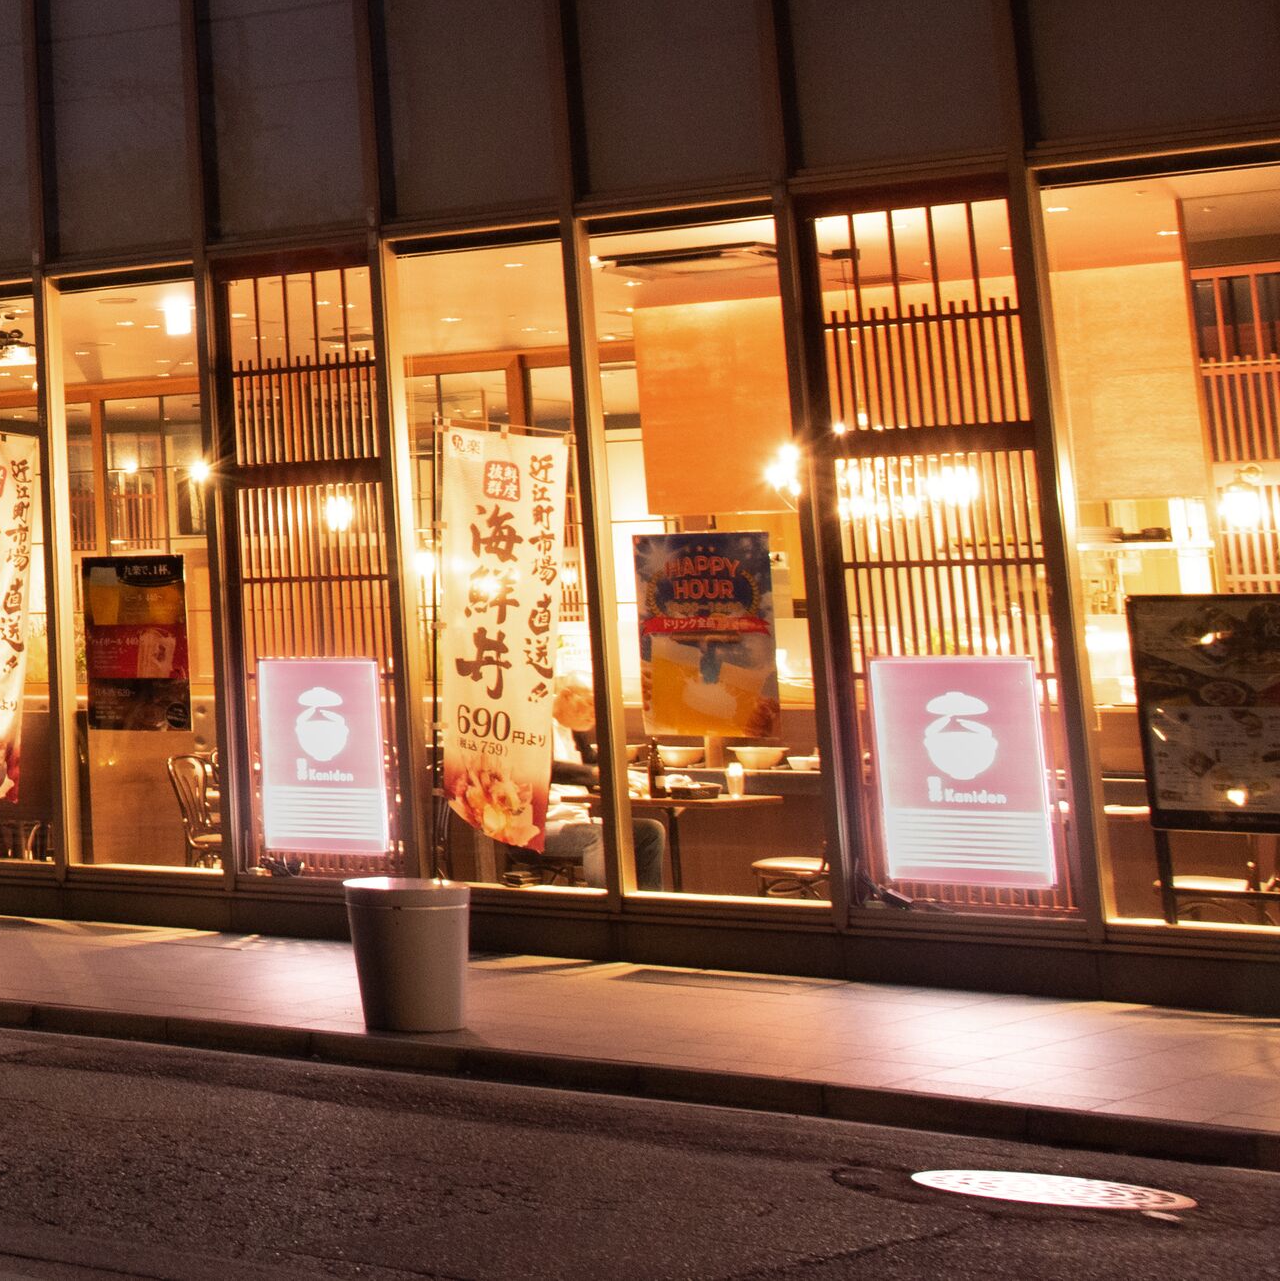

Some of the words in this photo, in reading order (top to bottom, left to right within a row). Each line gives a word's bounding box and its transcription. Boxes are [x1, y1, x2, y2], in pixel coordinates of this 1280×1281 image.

[664, 556, 740, 578] HAPPY
[673, 579, 734, 599] HOUR
[455, 503, 523, 700] 海鮮丼
